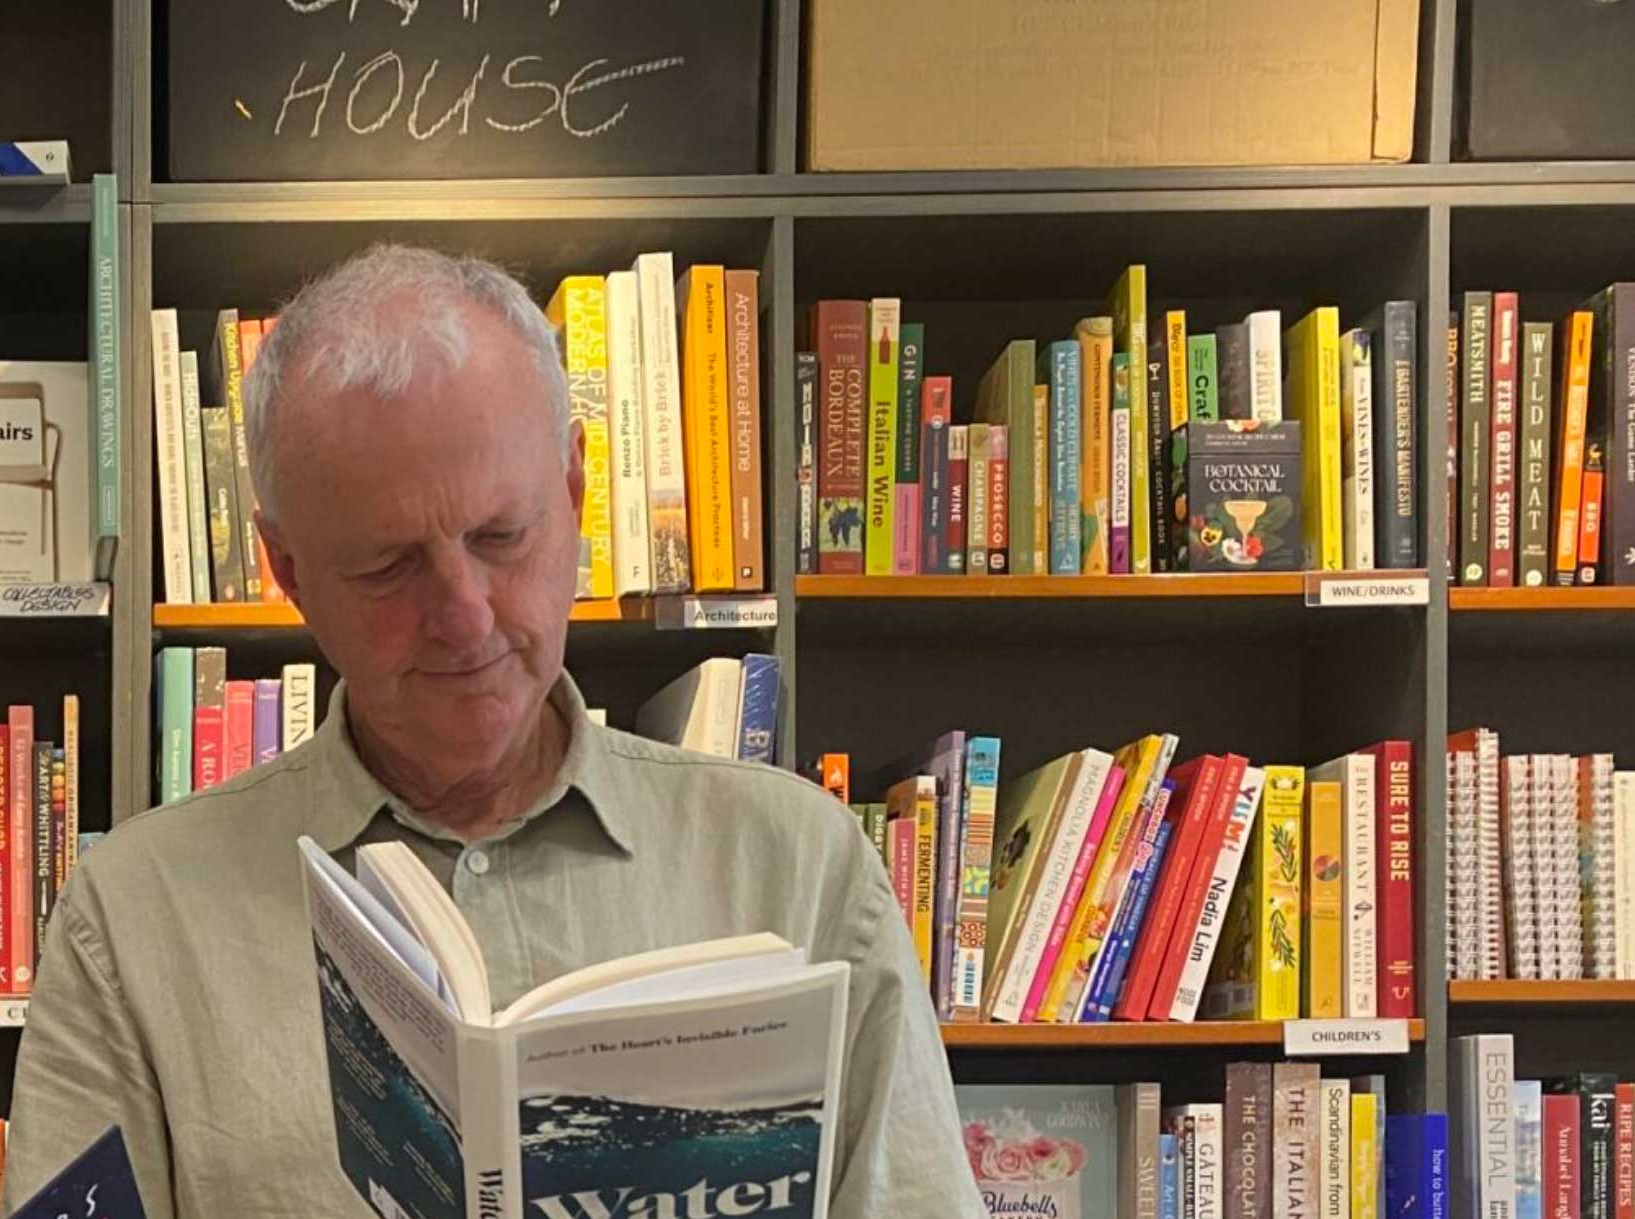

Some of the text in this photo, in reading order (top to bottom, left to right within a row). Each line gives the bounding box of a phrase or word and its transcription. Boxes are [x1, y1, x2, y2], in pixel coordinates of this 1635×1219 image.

[274, 51, 684, 140] HOUSE
[98, 256, 114, 468] ARCHITECTURAL DRAWINGS
[569, 289, 585, 393] MODERN
[587, 287, 606, 358] ATLAS
[1470, 305, 1485, 402] MEATSMITH
[705, 282, 720, 501] Architizer Architecture
[735, 292, 750, 472] Architecture at Home
[904, 344, 915, 381] GIN
[620, 399, 631, 477] Renzo Piano
[827, 369, 844, 476] BORDEAUX
[847, 369, 861, 477] COMPLETE
[1528, 333, 1546, 530] WILD MEAT
[872, 401, 891, 528] Italian Wine
[951, 485, 961, 522] WINE
[974, 461, 984, 540] CHAMPAGNE
[993, 464, 1004, 543] PROSECCO
[1116, 414, 1127, 522] CLASSIC COCKTAILS
[1204, 465, 1285, 478] BOTANICAL
[1209, 479, 1282, 493] COCKTAIL
[1495, 379, 1511, 550] FIRE GRILL SMOKE
[21, 599, 79, 612] DESIGN
[693, 608, 776, 622] Architecture
[1331, 585, 1415, 598] WINE/DRINKS
[38, 767, 49, 877] ART WHITTLING
[1354, 777, 1368, 890] RESTAURANT
[1390, 761, 1409, 881] SURE TO RISE
[917, 834, 931, 913] FERMENTING
[1191, 876, 1226, 962] Nadia Lim
[621, 1021, 787, 1051] Heart's Invisible Furies
[1311, 1031, 1381, 1042] CHILDREN'S
[1243, 1096, 1255, 1124] THE
[1288, 1088, 1304, 1127] THE
[1327, 1088, 1342, 1180] Scandinavian
[1486, 1053, 1507, 1187] ESSENTIAL
[1591, 1093, 1614, 1129] kai
[1139, 1156, 1154, 1218] SWEET
[1432, 1148, 1444, 1174] how
[1557, 1124, 1571, 1180] Annabel
[1620, 1104, 1632, 1206] RIPE RECIPES
[981, 1191, 1058, 1219] Bluebells
[1328, 1184, 1342, 1216] from
